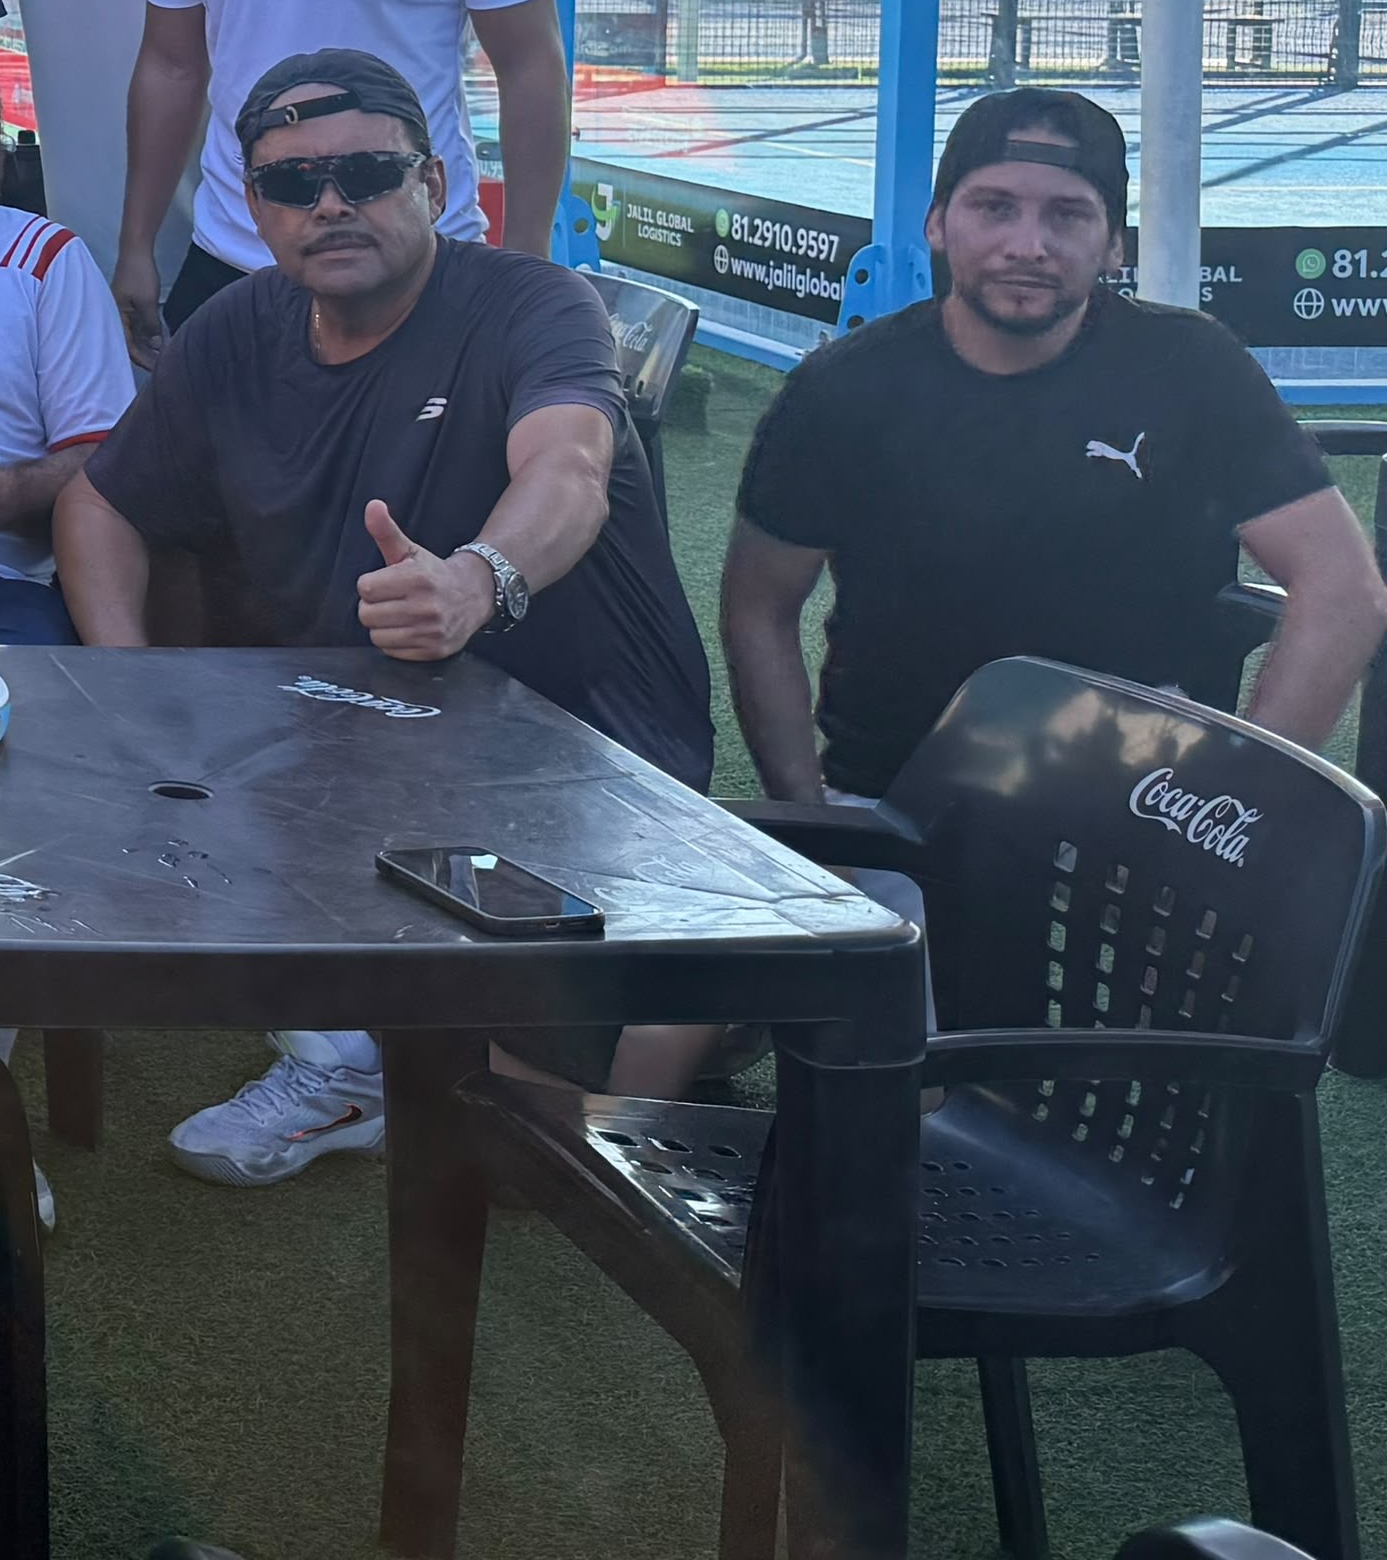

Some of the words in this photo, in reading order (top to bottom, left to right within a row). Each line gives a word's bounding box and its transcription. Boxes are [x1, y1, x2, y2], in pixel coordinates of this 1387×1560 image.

[626, 203, 655, 225] JALIL
[656, 209, 695, 233] GLOBAL
[637, 223, 683, 247] LOGISTICS
[730, 213, 840, 264] 81.2910.9597
[730, 256, 845, 302] www.jalilglobal
[1128, 767, 1264, 867] Coca-Cola
